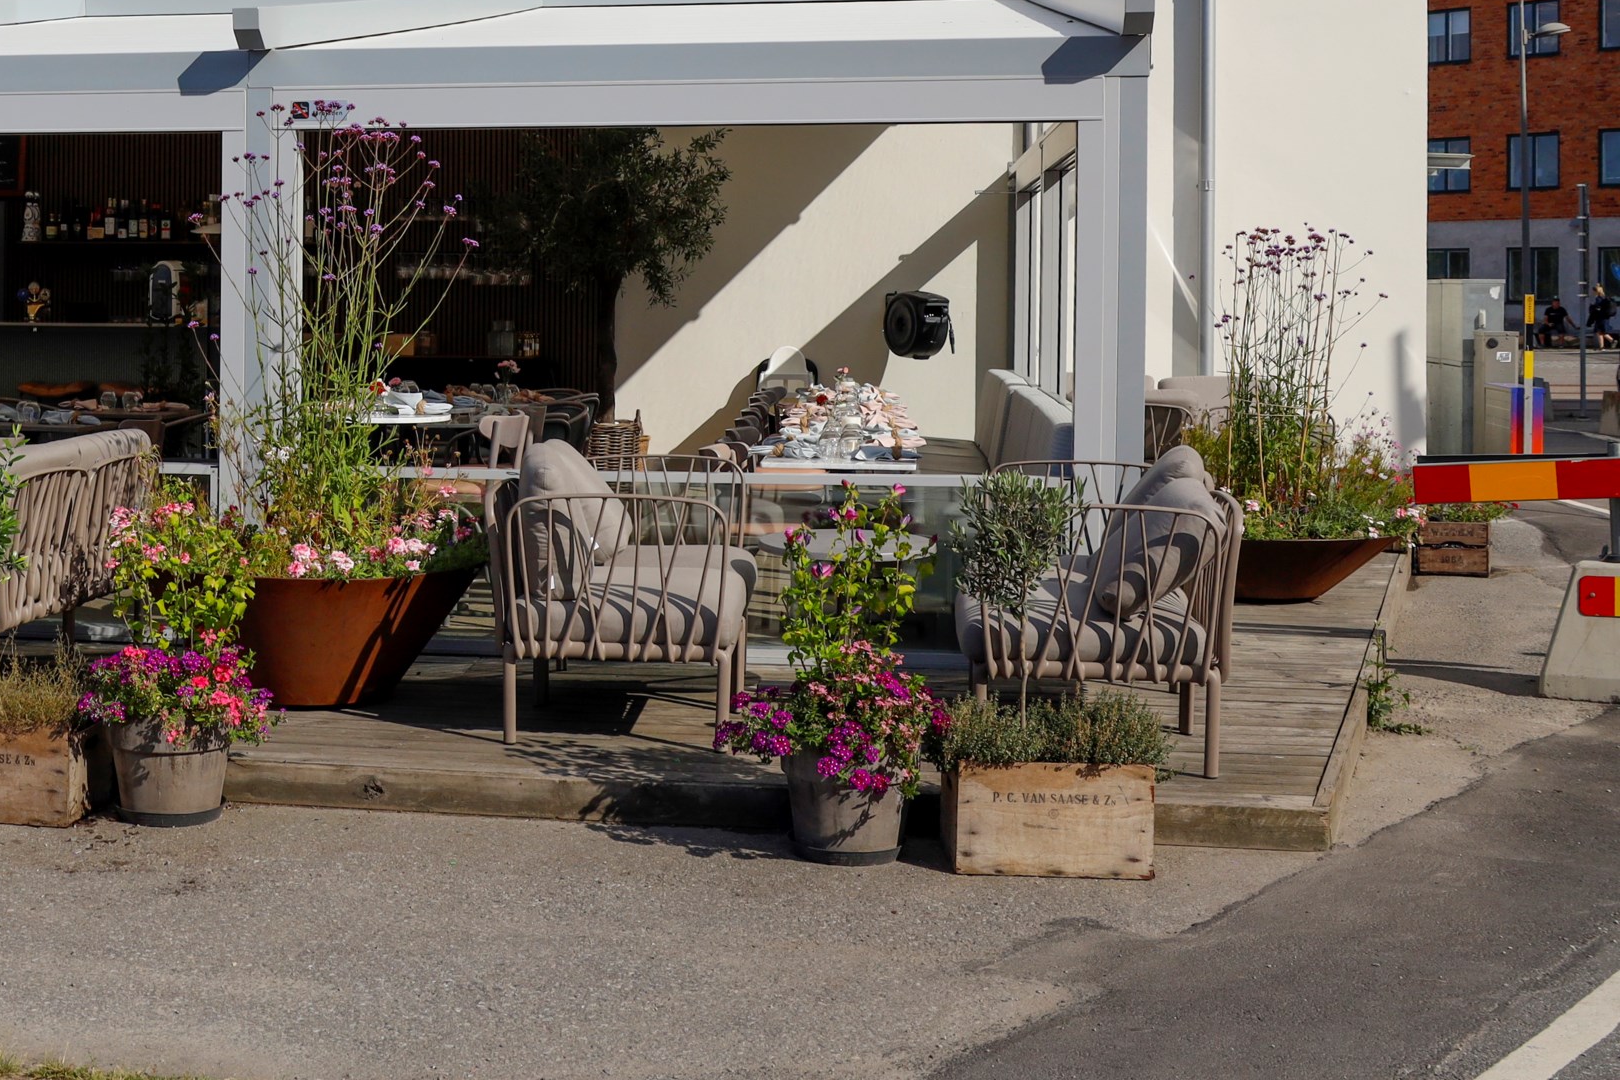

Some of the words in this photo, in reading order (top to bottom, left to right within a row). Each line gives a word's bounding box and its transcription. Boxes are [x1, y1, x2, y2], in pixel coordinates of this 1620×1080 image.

[14, 755, 21, 765] &
[1022, 792, 1046, 804] VAN
[1050, 793, 1089, 805] SAASE
[1092, 794, 1100, 806] &
